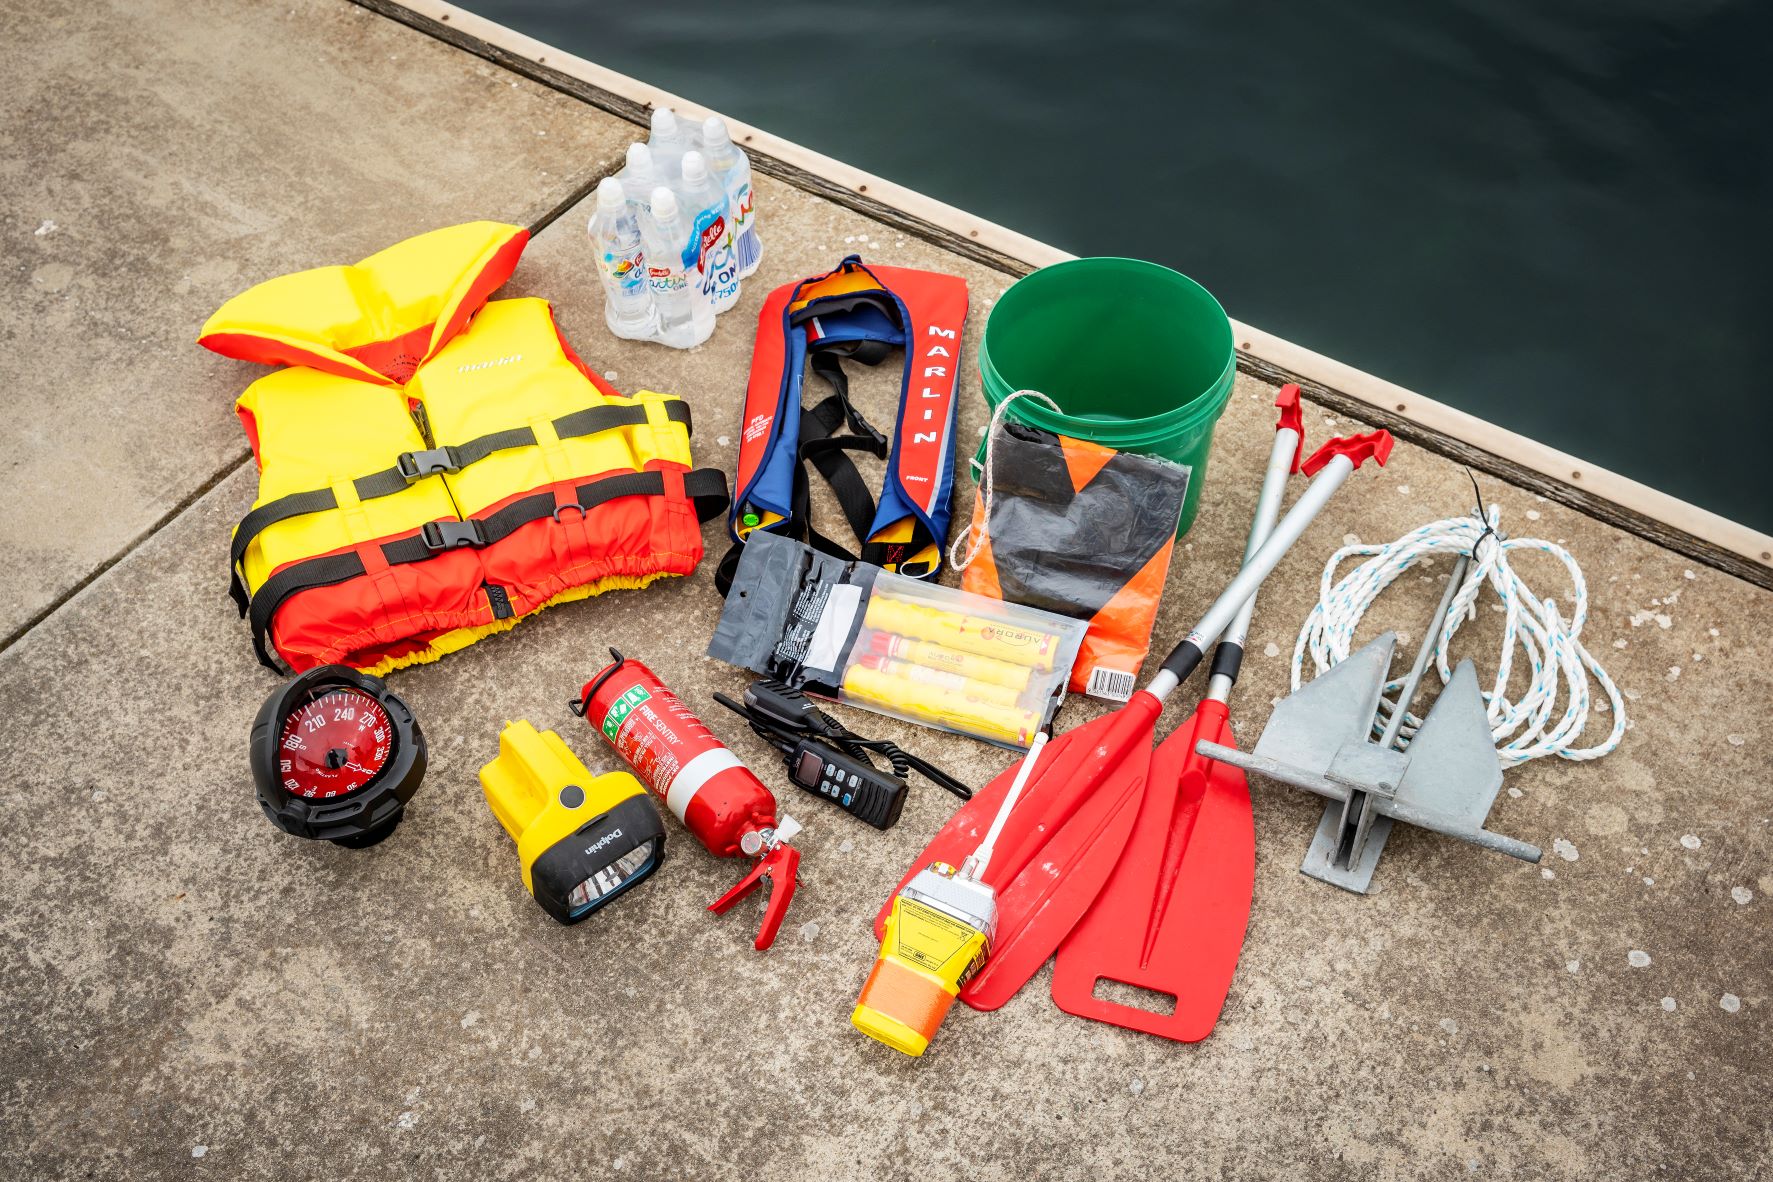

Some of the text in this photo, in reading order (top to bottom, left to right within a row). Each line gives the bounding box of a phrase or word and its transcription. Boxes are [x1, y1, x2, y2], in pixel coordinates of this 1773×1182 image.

[914, 326, 955, 444] MARLIN
[304, 714, 326, 732] 210
[334, 708, 354, 722] 240
[360, 712, 376, 728] 270
[640, 704, 658, 724] FIRE
[652, 719, 680, 744] SENTRY
[283, 734, 302, 751] 180
[374, 726, 385, 743] 300
[374, 746, 384, 760] 330
[280, 759, 292, 773] 150
[284, 778, 300, 790] 120
[585, 828, 622, 855] Dolphin
